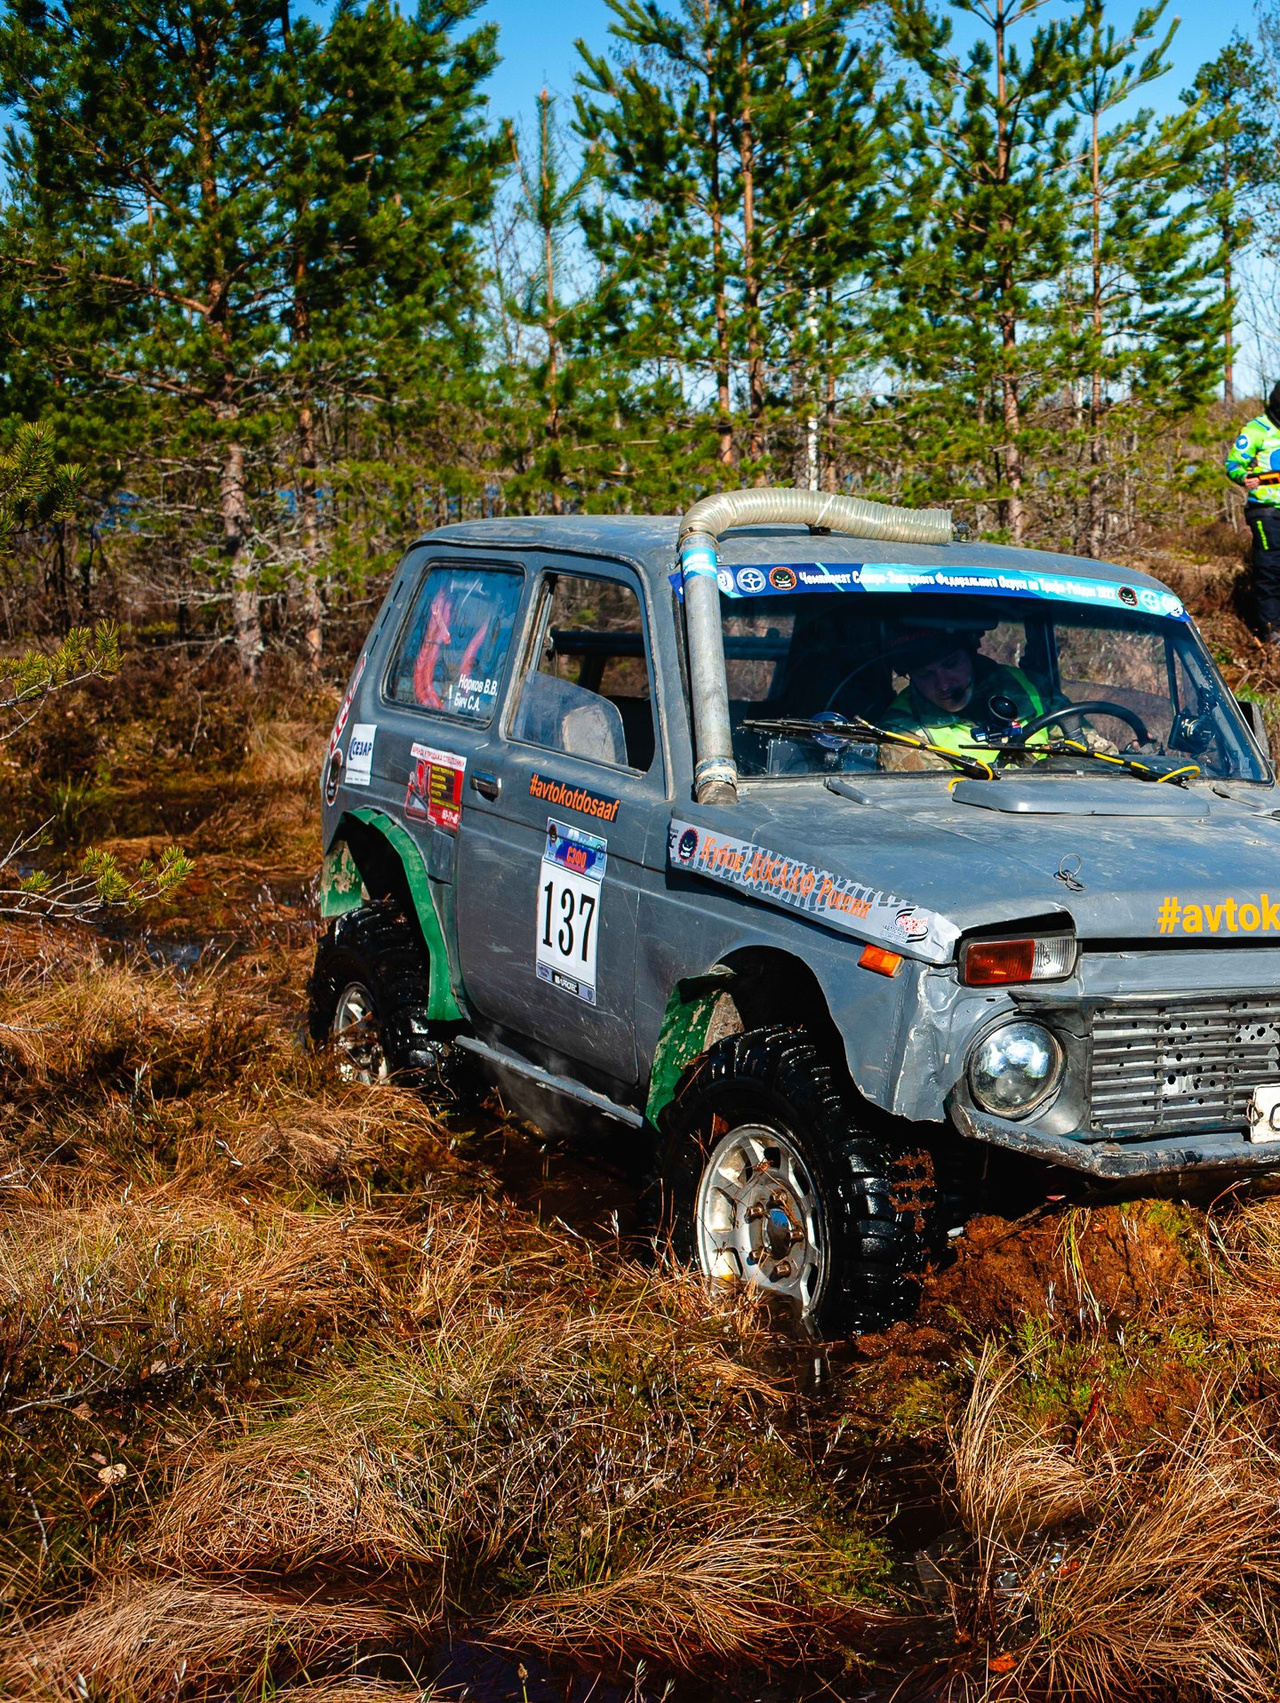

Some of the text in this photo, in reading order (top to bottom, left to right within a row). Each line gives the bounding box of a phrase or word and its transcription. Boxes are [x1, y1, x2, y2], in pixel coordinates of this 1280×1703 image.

[799, 571, 851, 584] Чемпионат
[935, 572, 998, 588] Федерального
[458, 673, 498, 696] Норков В.В.
[351, 740, 372, 757] СЕЗАР
[529, 773, 620, 821] #avtokotdosaaf
[567, 846, 587, 868] СЗФО
[700, 835, 744, 873] Кубок
[744, 852, 815, 897] ДОСААФ
[817, 877, 872, 920] России
[542, 880, 595, 962] 137
